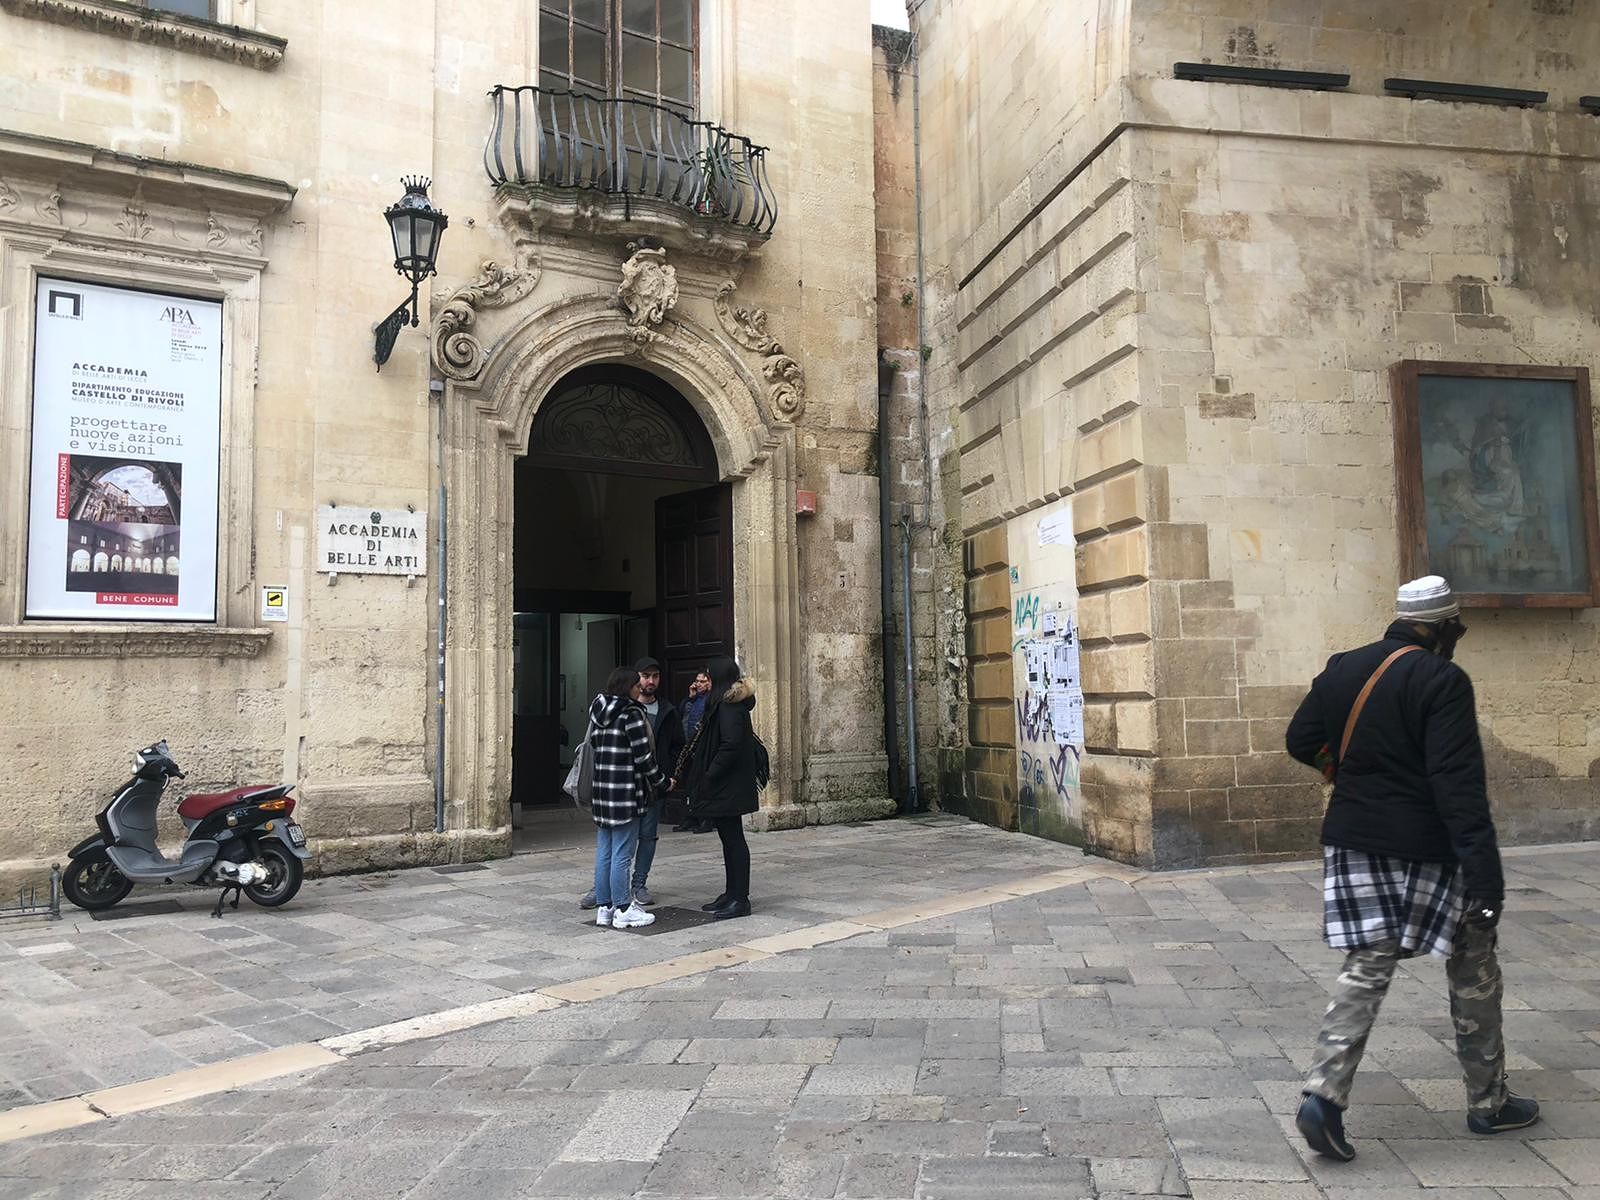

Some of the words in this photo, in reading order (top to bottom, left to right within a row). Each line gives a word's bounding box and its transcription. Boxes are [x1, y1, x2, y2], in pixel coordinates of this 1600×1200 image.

[72, 362, 148, 377] ACCADEMIA
[71, 381, 132, 394] DIPARTIMENTO
[135, 388, 184, 399] EDUCAZIONE
[71, 388, 126, 400] CASTELLO
[147, 396, 184, 407] RIVOLI
[70, 416, 167, 433] progettare
[70, 428, 119, 440] nuove
[128, 433, 184, 447] azioni
[69, 440, 79, 449] e
[88, 440, 156, 455] visioni
[328, 523, 417, 538] ACCADEMIA
[366, 540, 382, 552] DI
[327, 552, 377, 566] BELLE
[384, 555, 418, 568] ARTI
[133, 596, 175, 604] COMUNE
